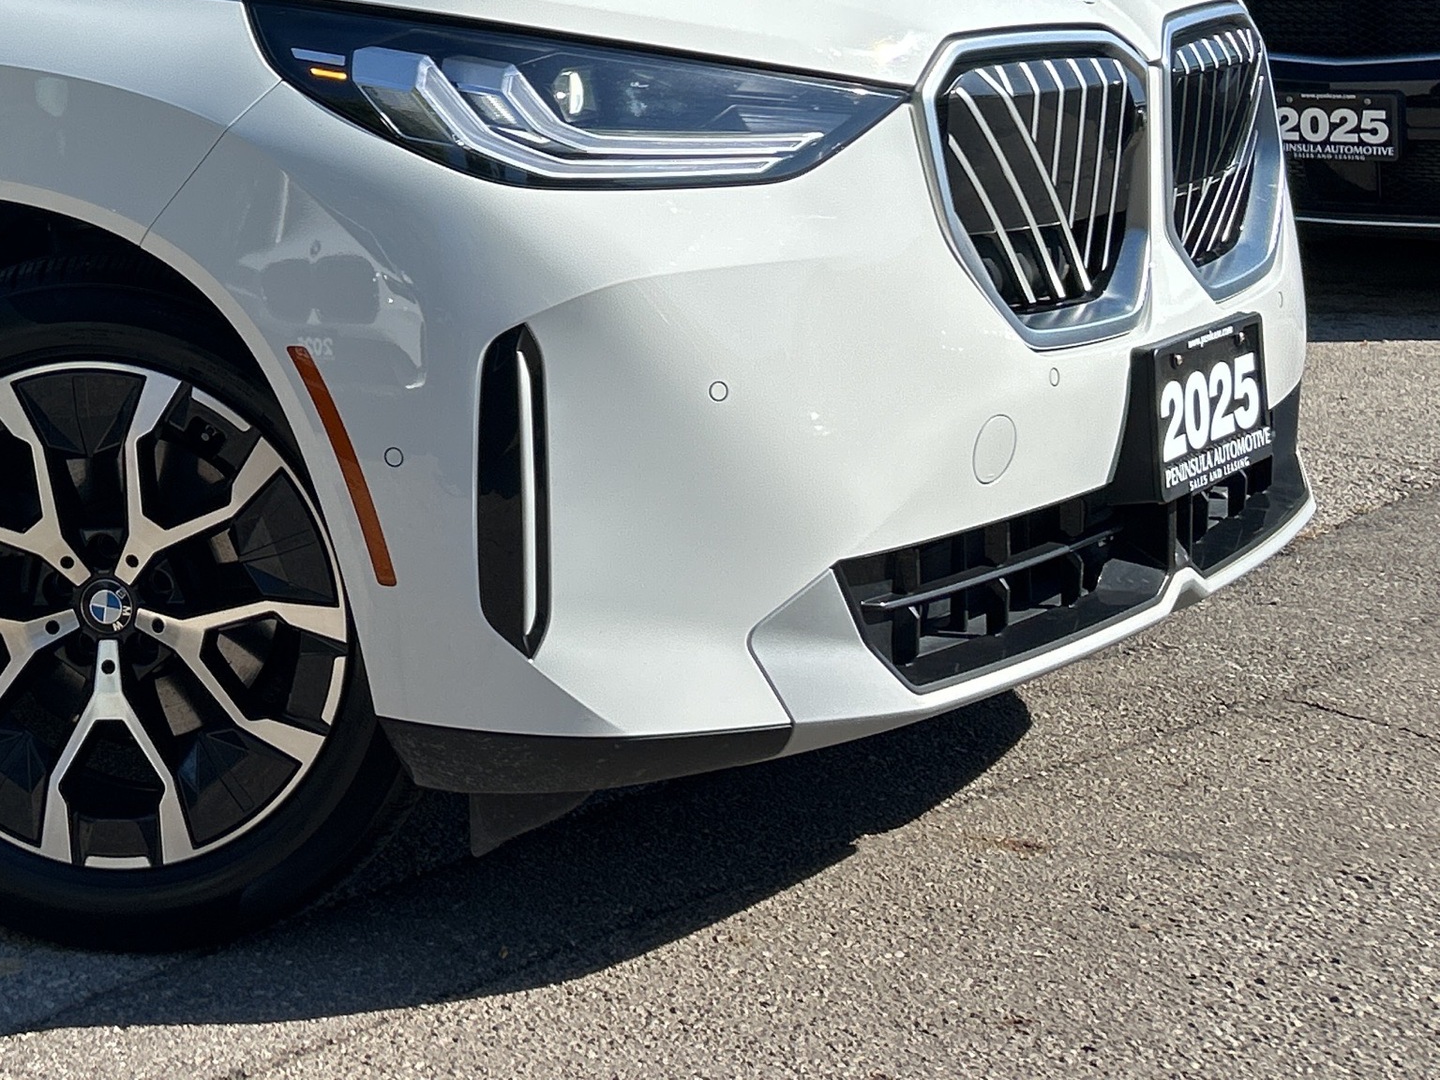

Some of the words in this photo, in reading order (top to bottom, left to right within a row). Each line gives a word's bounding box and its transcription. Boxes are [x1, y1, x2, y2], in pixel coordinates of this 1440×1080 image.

[1277, 107, 1389, 144] 2025
[1324, 144, 1394, 156] AUTOMOTIVE
[1161, 352, 1259, 462] 2025
[1165, 451, 1213, 488] PENINSULA
[1214, 427, 1272, 466] AUTOMOTIVE
[1189, 474, 1208, 491] SALES
[1209, 469, 1222, 482] AND
[1223, 456, 1250, 475] LEASING
